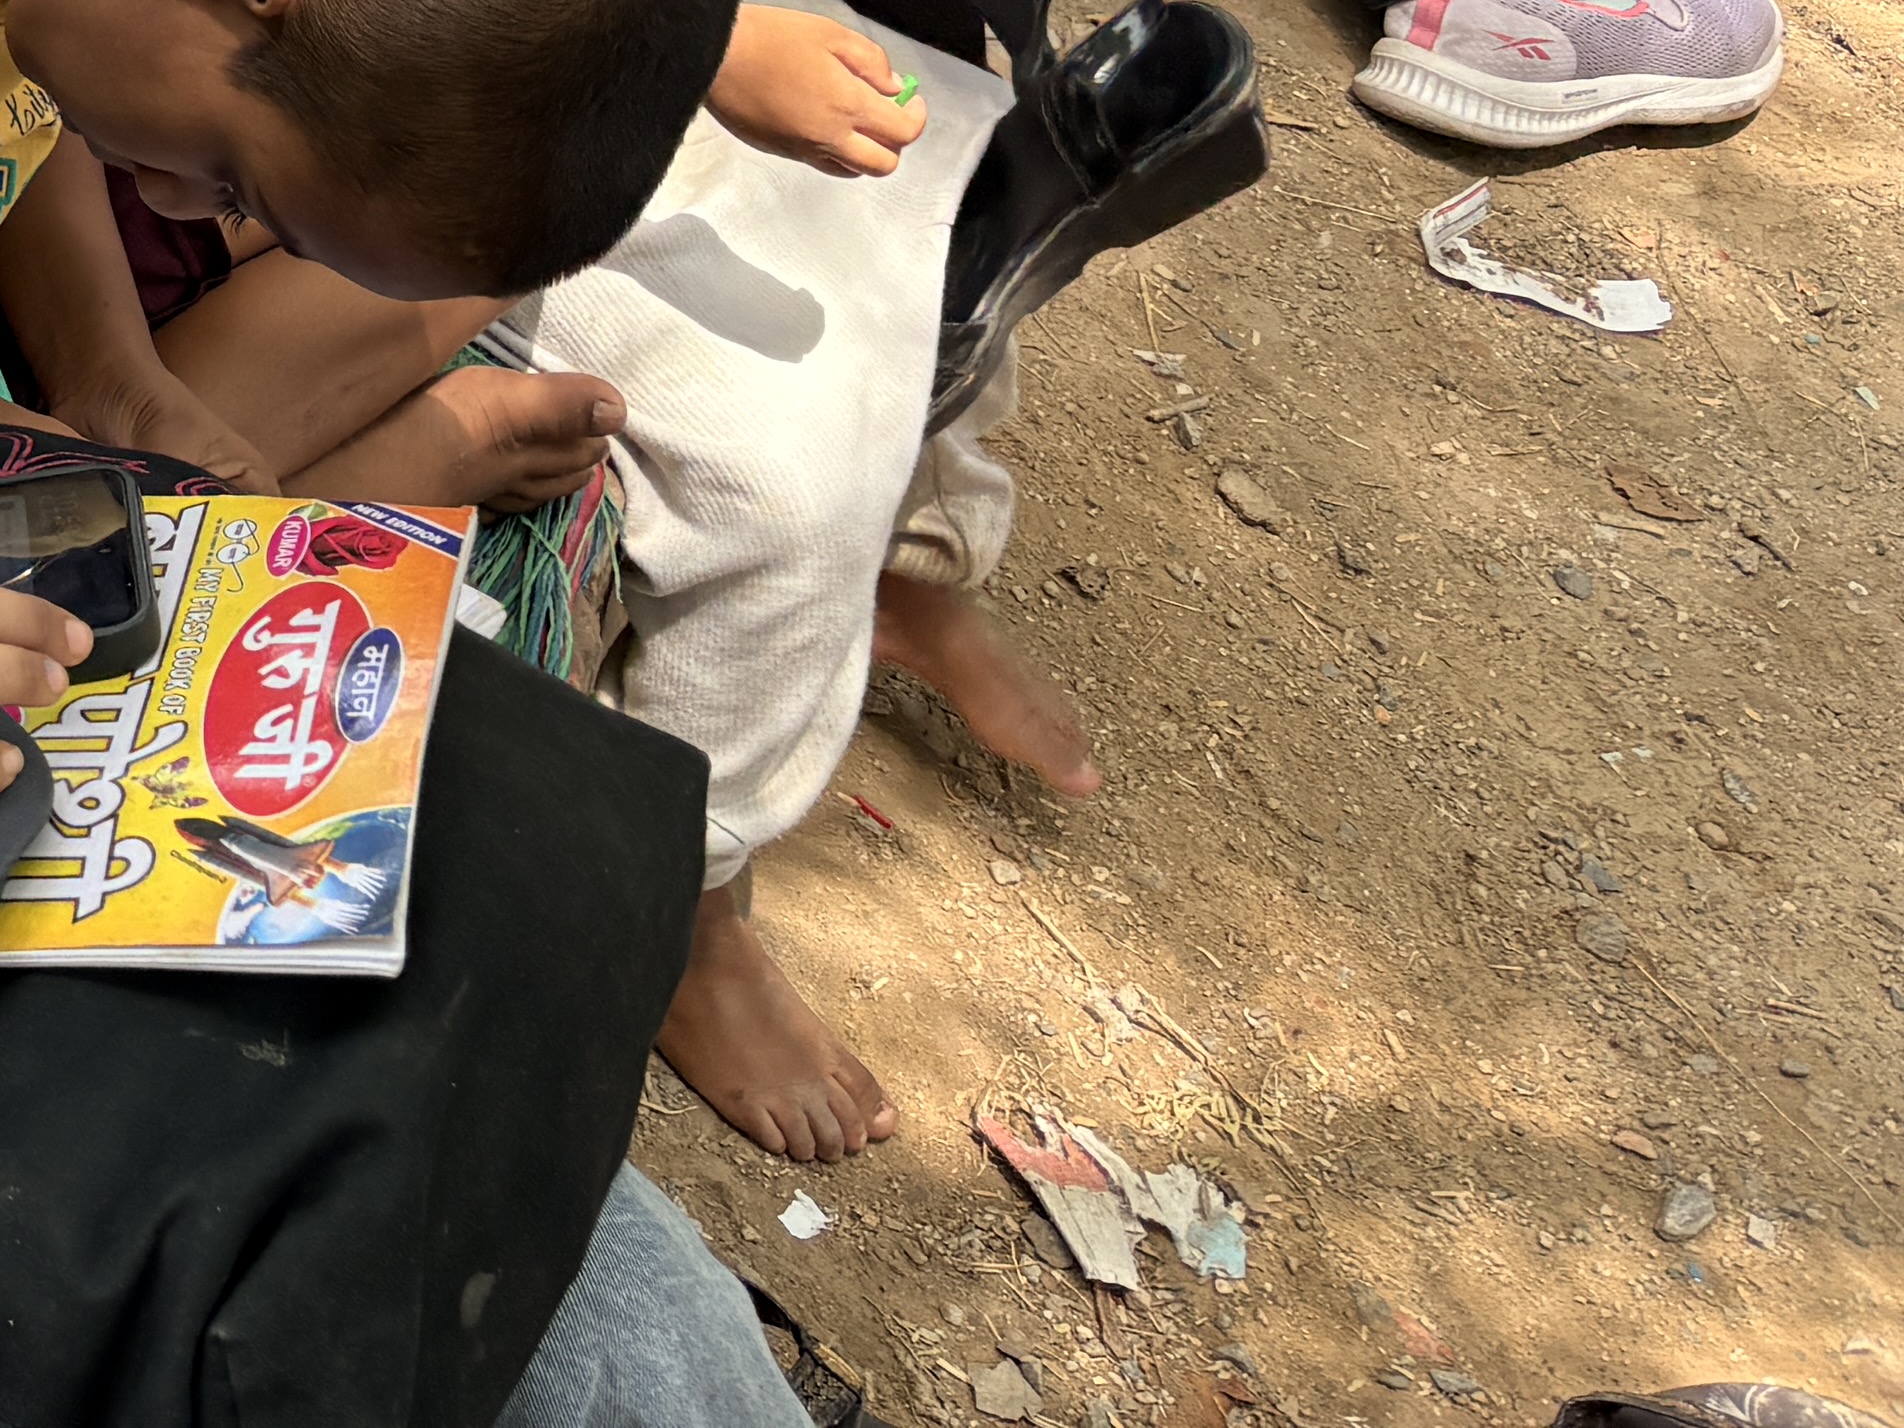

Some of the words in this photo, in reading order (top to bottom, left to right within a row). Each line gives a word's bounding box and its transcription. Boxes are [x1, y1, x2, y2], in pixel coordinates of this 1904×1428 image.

[272, 520, 303, 568] KUMAR
[352, 503, 386, 520] NEW
[386, 513, 448, 545] EDITION
[194, 567, 224, 593] MY
[180, 596, 217, 644] FIRST
[164, 647, 202, 691] BOOK
[346, 643, 390, 722] महान
[158, 693, 187, 716] OF
[233, 694, 334, 791] जी
